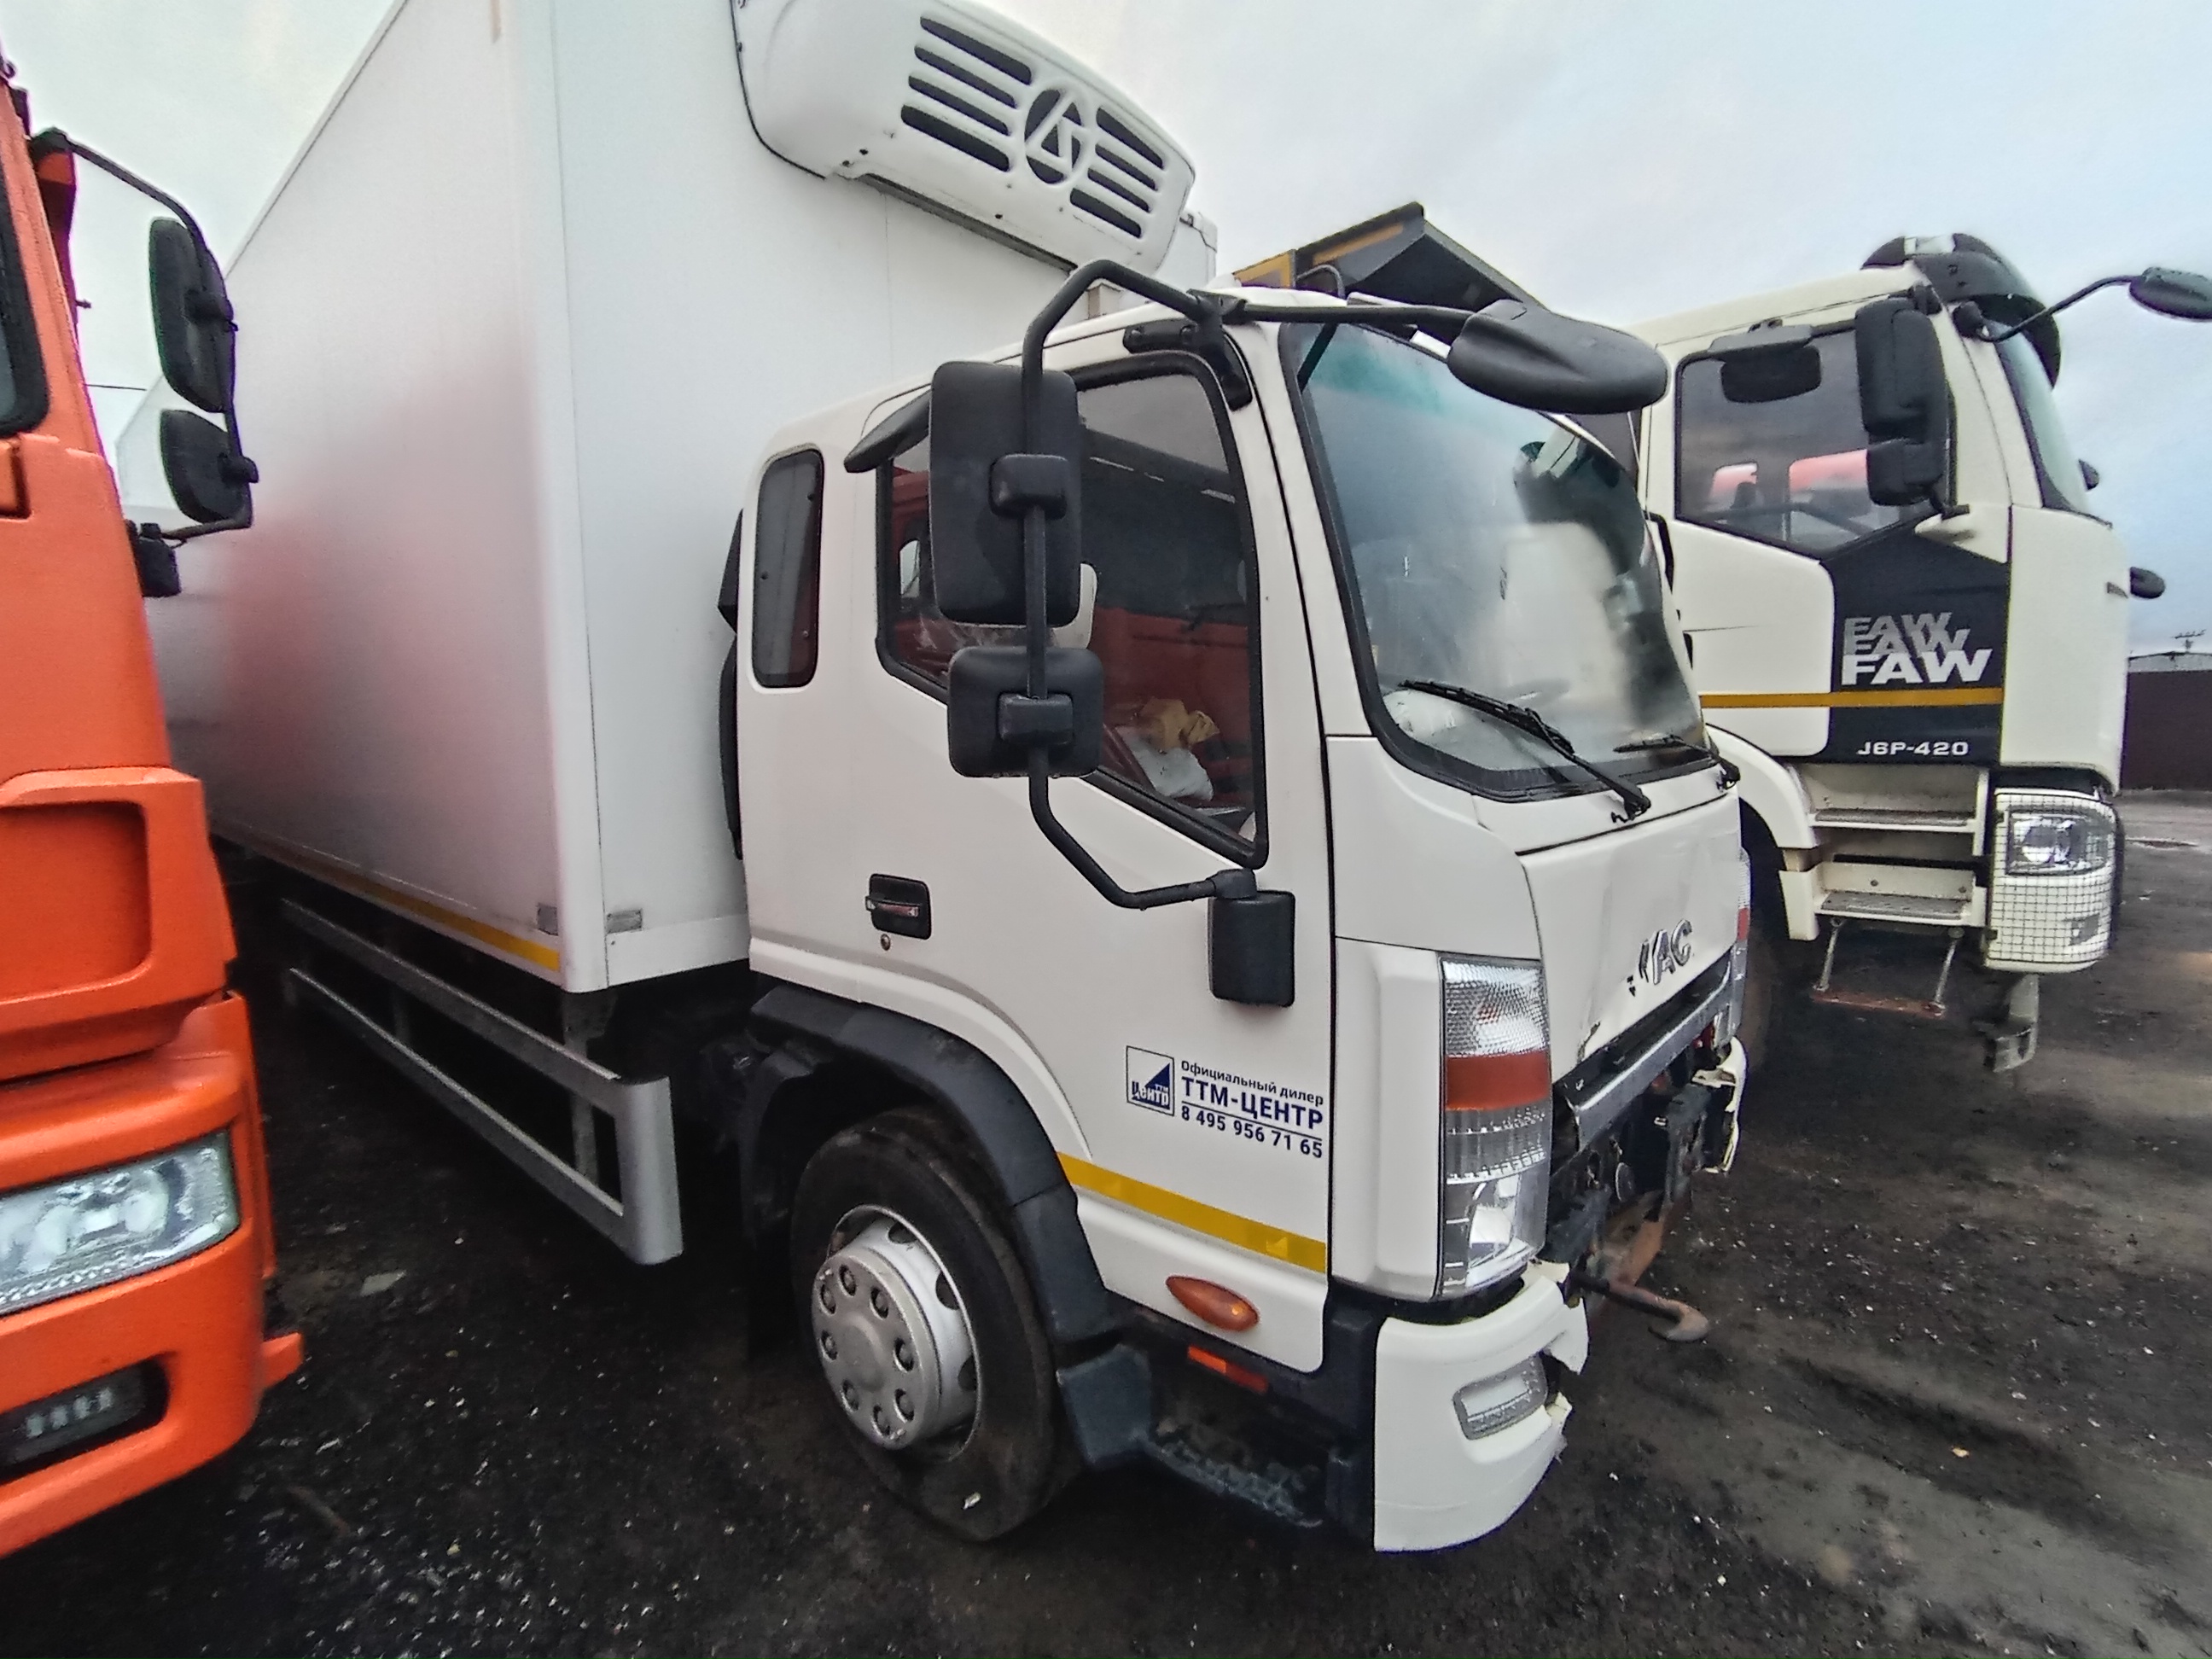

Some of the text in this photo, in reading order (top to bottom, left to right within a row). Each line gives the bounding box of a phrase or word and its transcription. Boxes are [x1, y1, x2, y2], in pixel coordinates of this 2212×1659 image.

[1842, 649, 1993, 685] FAW
[1856, 741, 1969, 756] J6P-420
[1181, 1060, 1324, 1106] Официальный дилер
[1181, 1076, 1324, 1130] ТТМ-ЦЕНТР
[1181, 1105, 1323, 1158] 8 495 956 71 65
